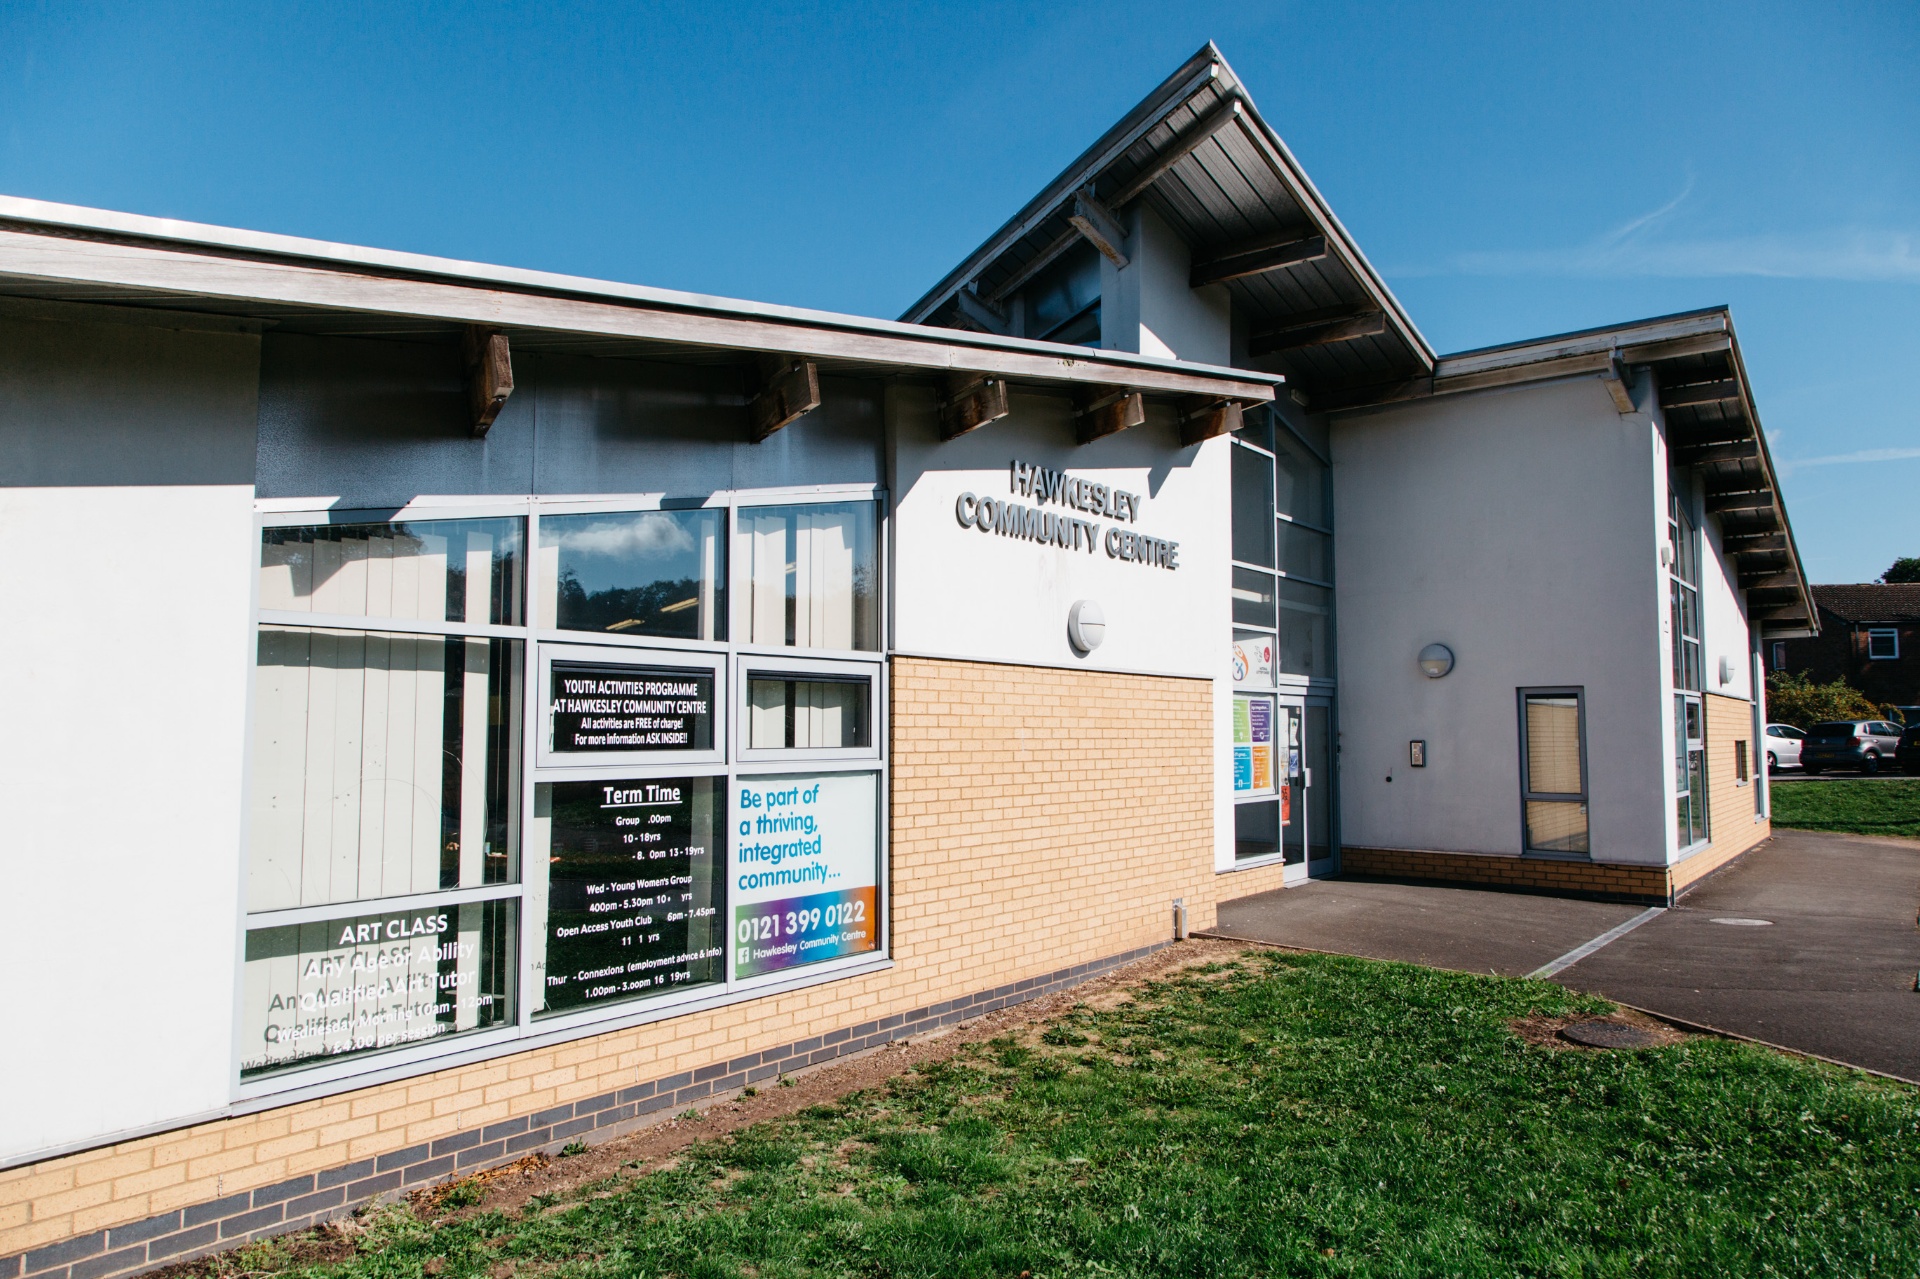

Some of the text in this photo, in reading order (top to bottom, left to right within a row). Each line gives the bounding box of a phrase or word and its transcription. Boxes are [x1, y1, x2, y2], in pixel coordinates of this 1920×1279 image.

[1011, 459, 1141, 523] HAWKESLEY
[956, 491, 1180, 570] COMMUNITY CENTRE
[564, 679, 698, 696] YOUTH ACTIVITIES PROGRAMME
[553, 698, 707, 714] AT HAWKESLEY COMMUNITY CENTRE
[581, 717, 684, 730] All activities are FREE of charge!
[574, 732, 688, 745] For more information ASK INSIDE!!
[603, 785, 681, 804] Term Time
[740, 783, 820, 811] Be part of
[615, 816, 640, 827] Group
[739, 811, 819, 836] a thriving,
[623, 834, 633, 844] 10
[640, 832, 661, 843] 18yrs
[669, 848, 679, 857] 13
[685, 846, 704, 856] 19yrs
[739, 834, 822, 865] integrated
[587, 883, 605, 895] Wed
[610, 881, 636, 892] Young
[637, 877, 669, 889] Women's
[670, 875, 692, 886] Group
[738, 860, 841, 890] community...
[589, 902, 617, 913] 400pm
[623, 897, 653, 910] 5.30pm
[681, 892, 692, 902] yrs
[339, 914, 448, 945] ART CLASS
[557, 926, 579, 938] Open
[580, 922, 609, 935] Access
[610, 917, 634, 930] Youth
[635, 916, 652, 927] Club
[667, 912, 684, 922] 6pm
[689, 907, 716, 919] 7.45pm
[738, 900, 866, 943] 0121 399 0122
[622, 936, 632, 946] 11
[648, 933, 660, 943] yrs
[753, 942, 798, 959] Hawkesley
[800, 933, 839, 950] Community
[841, 929, 866, 942] Centre
[305, 941, 475, 980] Any Age or Ability
[547, 975, 568, 987] Thur
[578, 965, 624, 981] Connexions
[627, 955, 675, 973] (employment
[676, 951, 698, 963] advice
[699, 949, 705, 959] &
[300, 969, 476, 1012] Qualified Art Tutor
[585, 985, 616, 998] 1.00pm
[654, 974, 664, 984] 16
[670, 970, 691, 982] 19yrs
[277, 1019, 356, 1042] Wednesday
[359, 1008, 413, 1028] Morning
[461, 994, 493, 1010] 12pm
[332, 1022, 446, 1055] £4.00 per session
